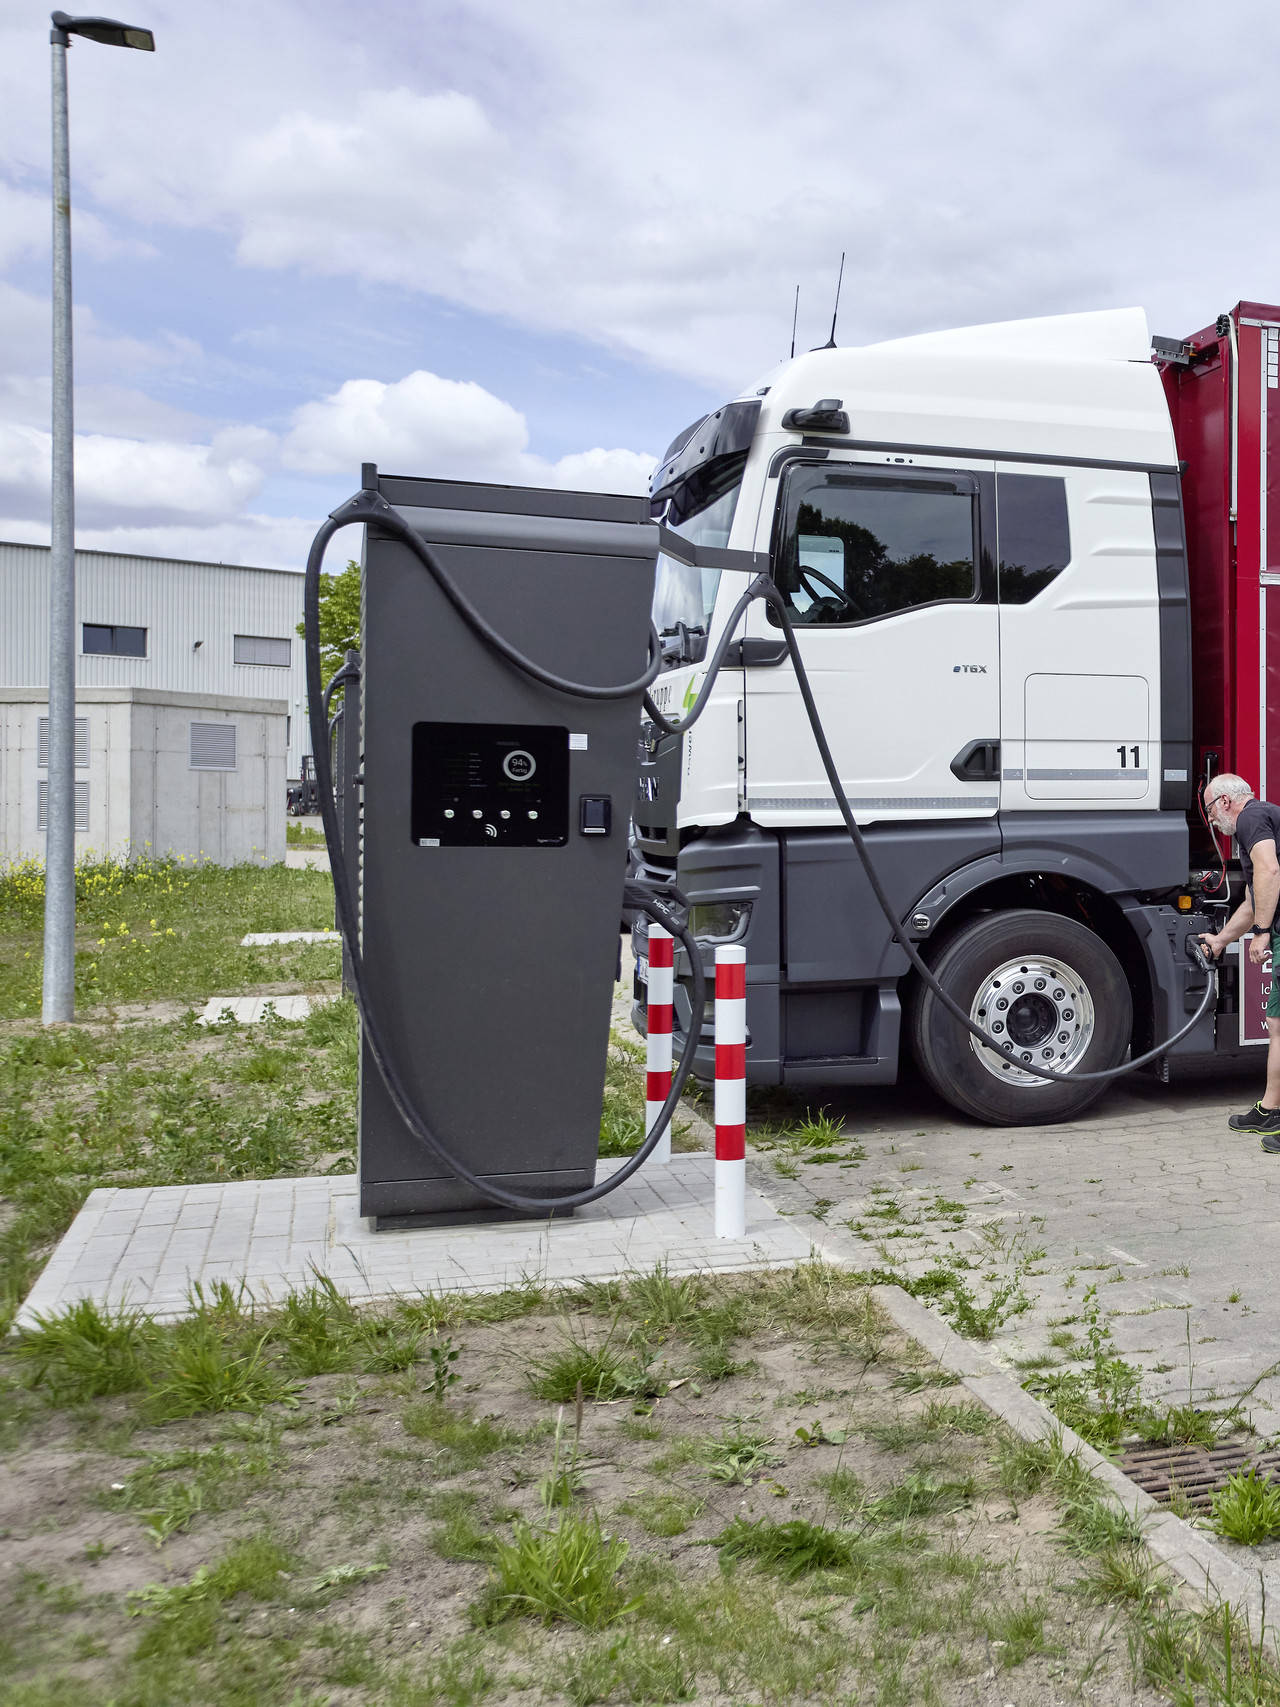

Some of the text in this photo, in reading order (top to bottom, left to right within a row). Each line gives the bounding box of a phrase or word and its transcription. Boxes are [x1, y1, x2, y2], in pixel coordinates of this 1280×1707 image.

[953, 664, 987, 674] eTGX
[1116, 745, 1140, 768] 11
[652, 898, 671, 915] HPC
